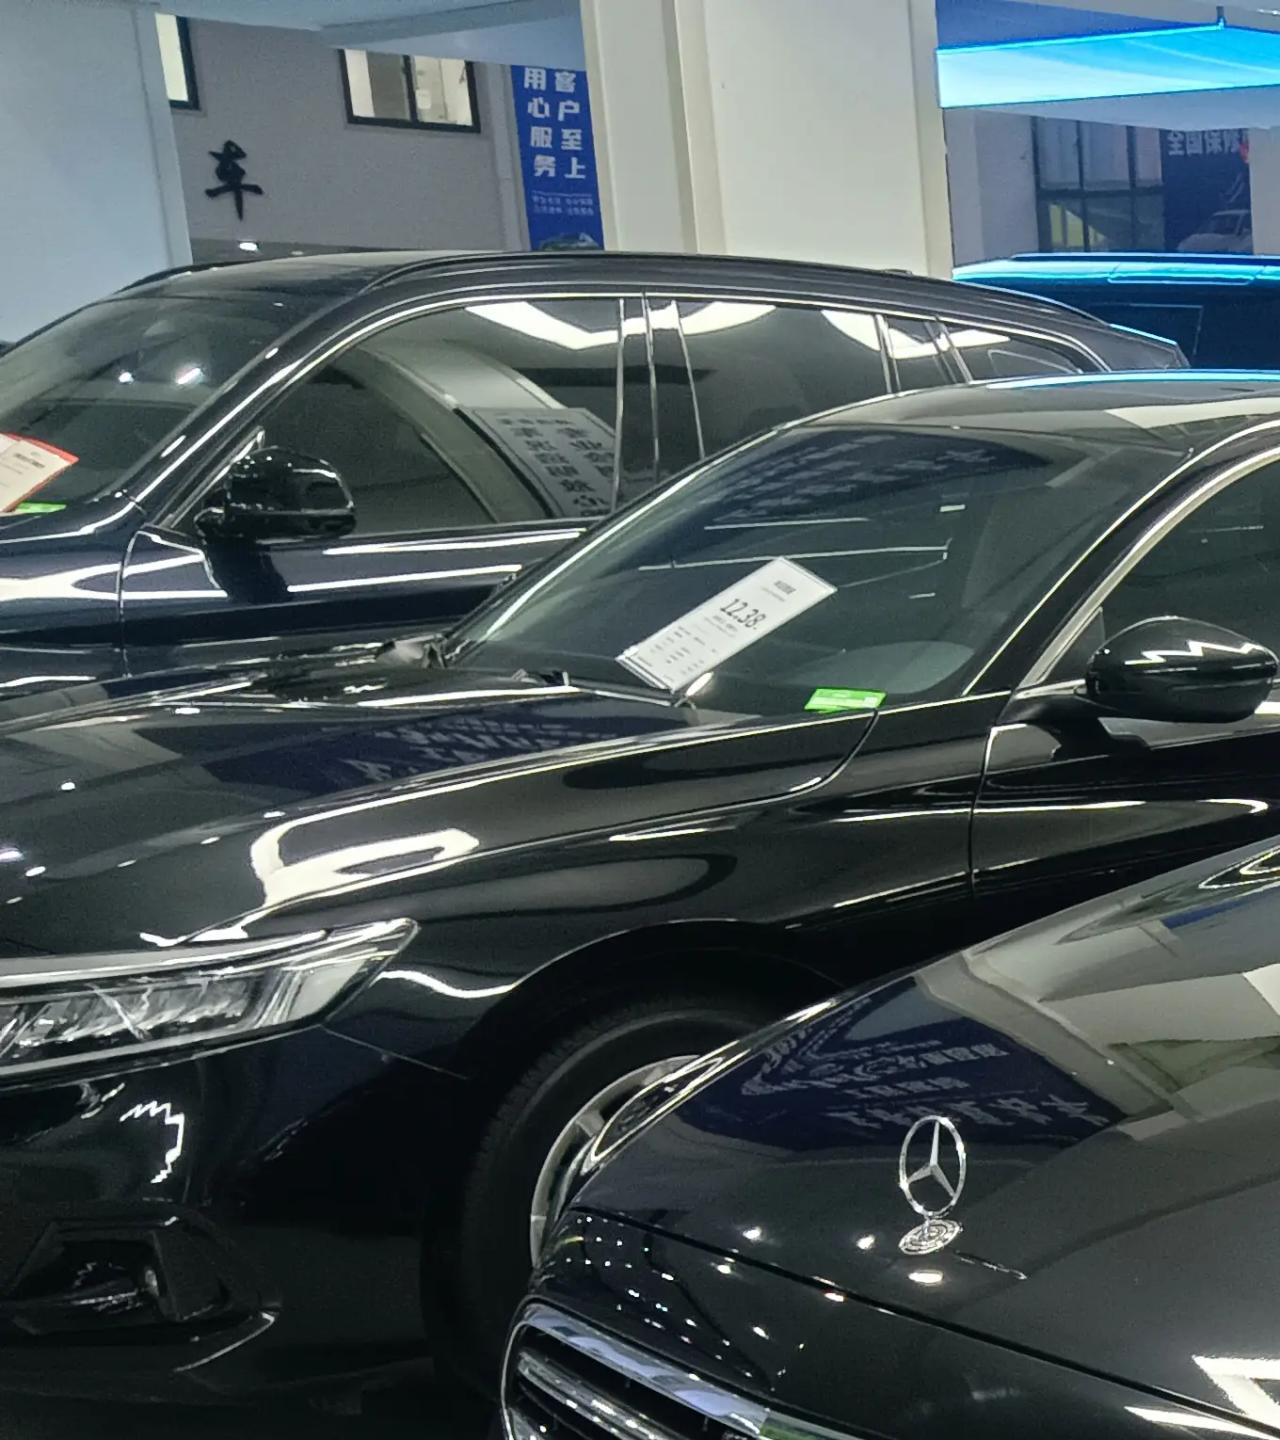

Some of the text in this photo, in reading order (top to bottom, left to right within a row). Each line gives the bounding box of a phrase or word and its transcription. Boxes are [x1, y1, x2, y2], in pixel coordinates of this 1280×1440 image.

[524, 67, 556, 177] 用心服务
[554, 71, 586, 179] 客户至上
[1166, 129, 1249, 156] 全国保修
[205, 140, 263, 221] 车
